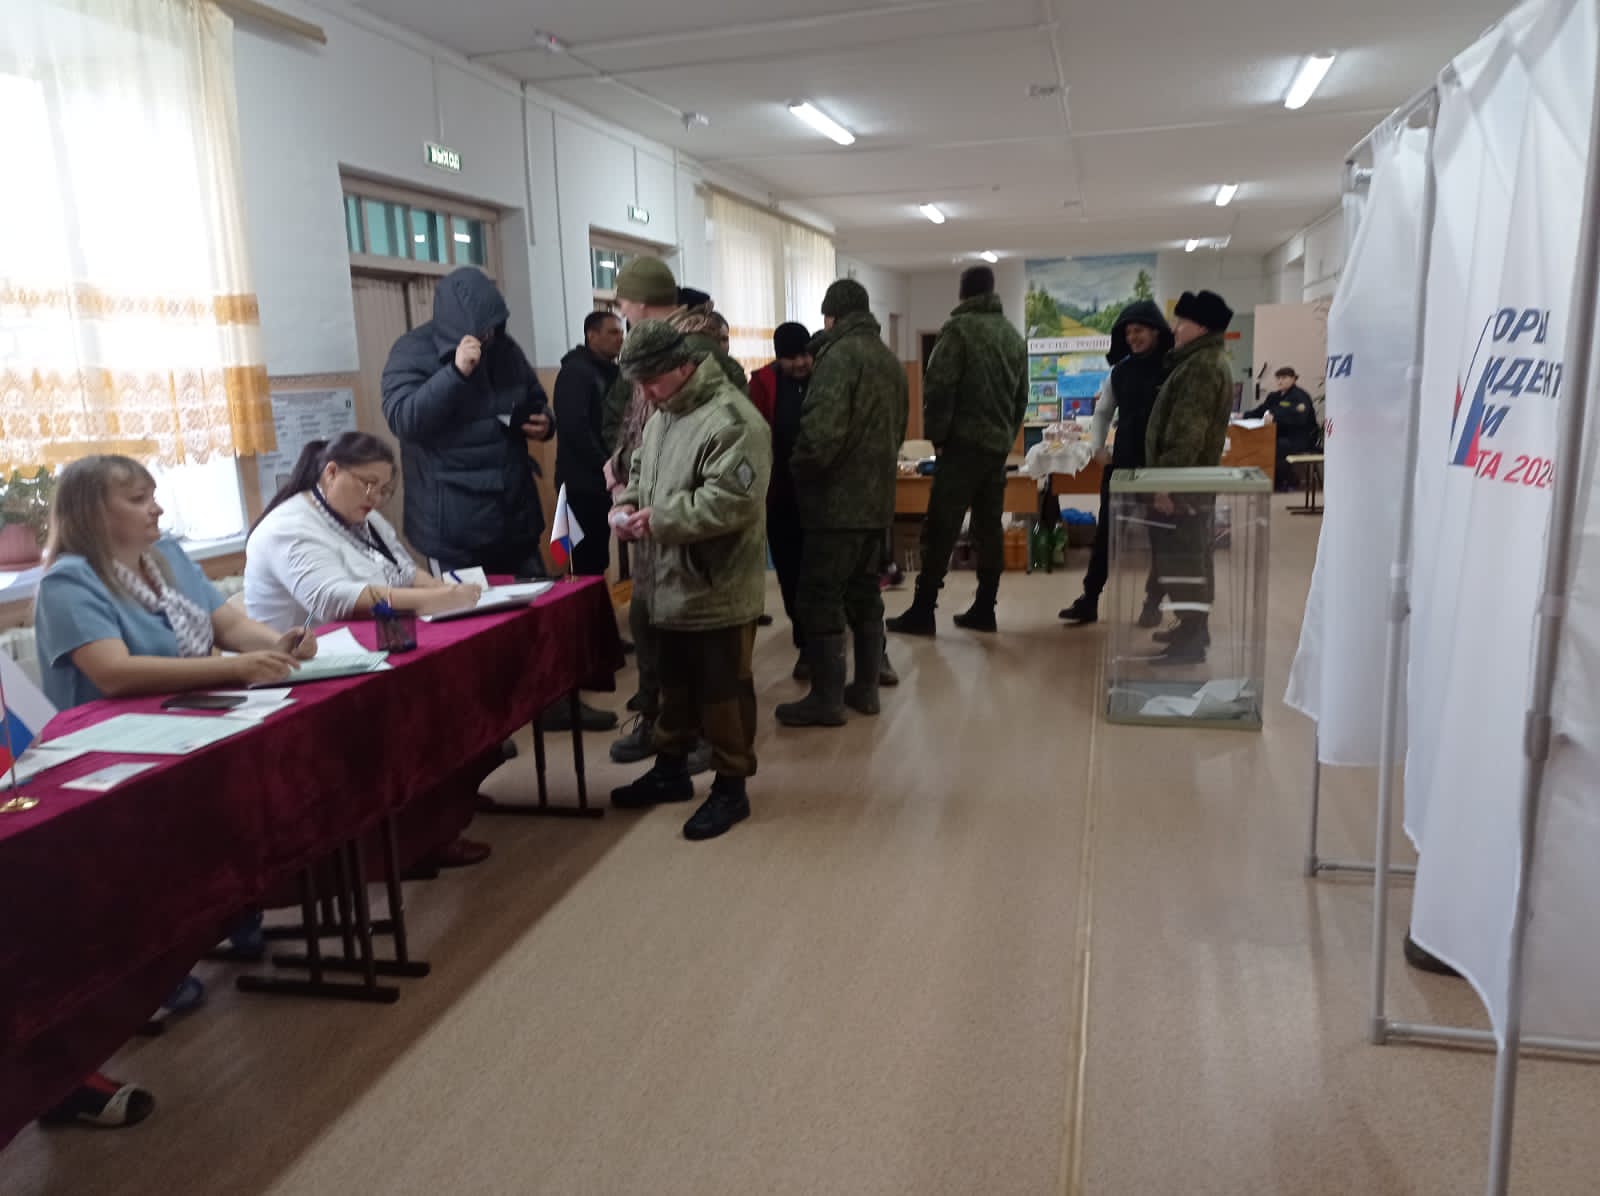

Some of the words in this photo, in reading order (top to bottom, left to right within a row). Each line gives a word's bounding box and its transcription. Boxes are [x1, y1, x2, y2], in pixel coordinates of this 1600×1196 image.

[1326, 353, 1354, 379] ТА
[1484, 356, 1563, 399] ИДЕНТ
[1479, 405, 1511, 438] И
[1475, 450, 1503, 480] ТА
